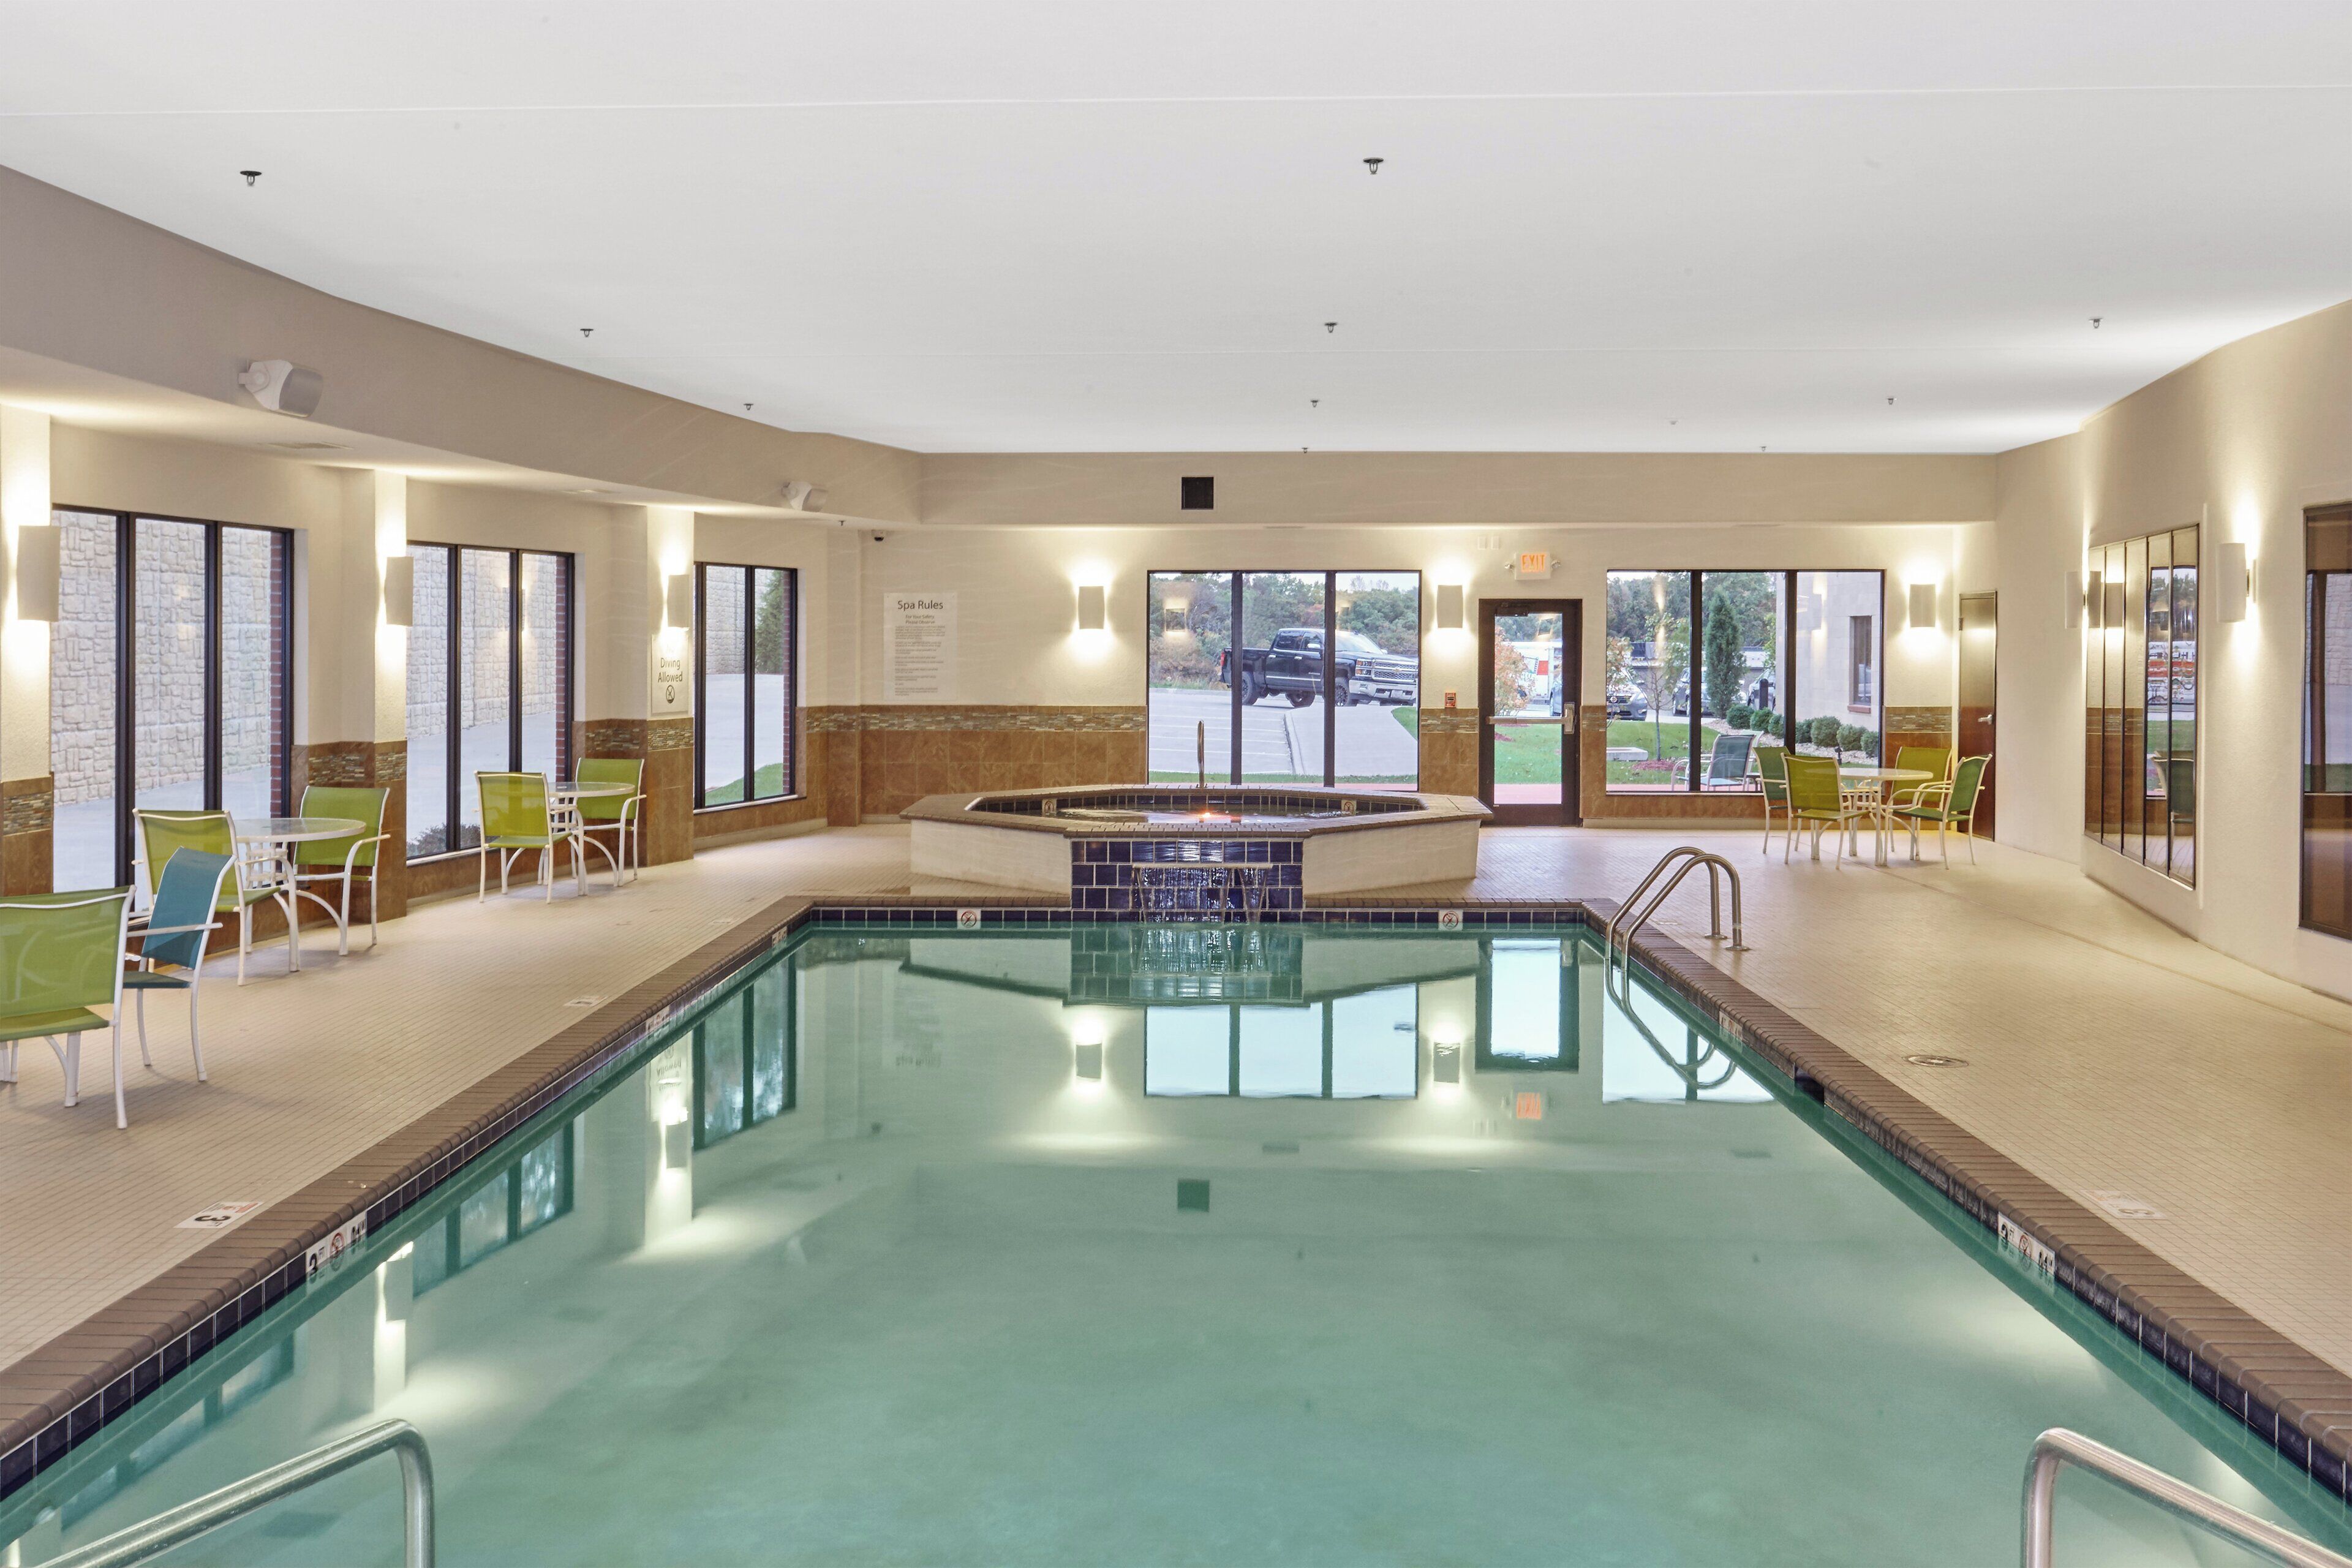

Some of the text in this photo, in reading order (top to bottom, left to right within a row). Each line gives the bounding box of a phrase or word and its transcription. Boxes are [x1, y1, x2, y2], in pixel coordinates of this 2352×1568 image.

[1522, 554, 1545, 570] EXIT
[897, 600, 943, 611] Spa Rules
[660, 657, 680, 670] Diving
[657, 671, 683, 683] Allowed
